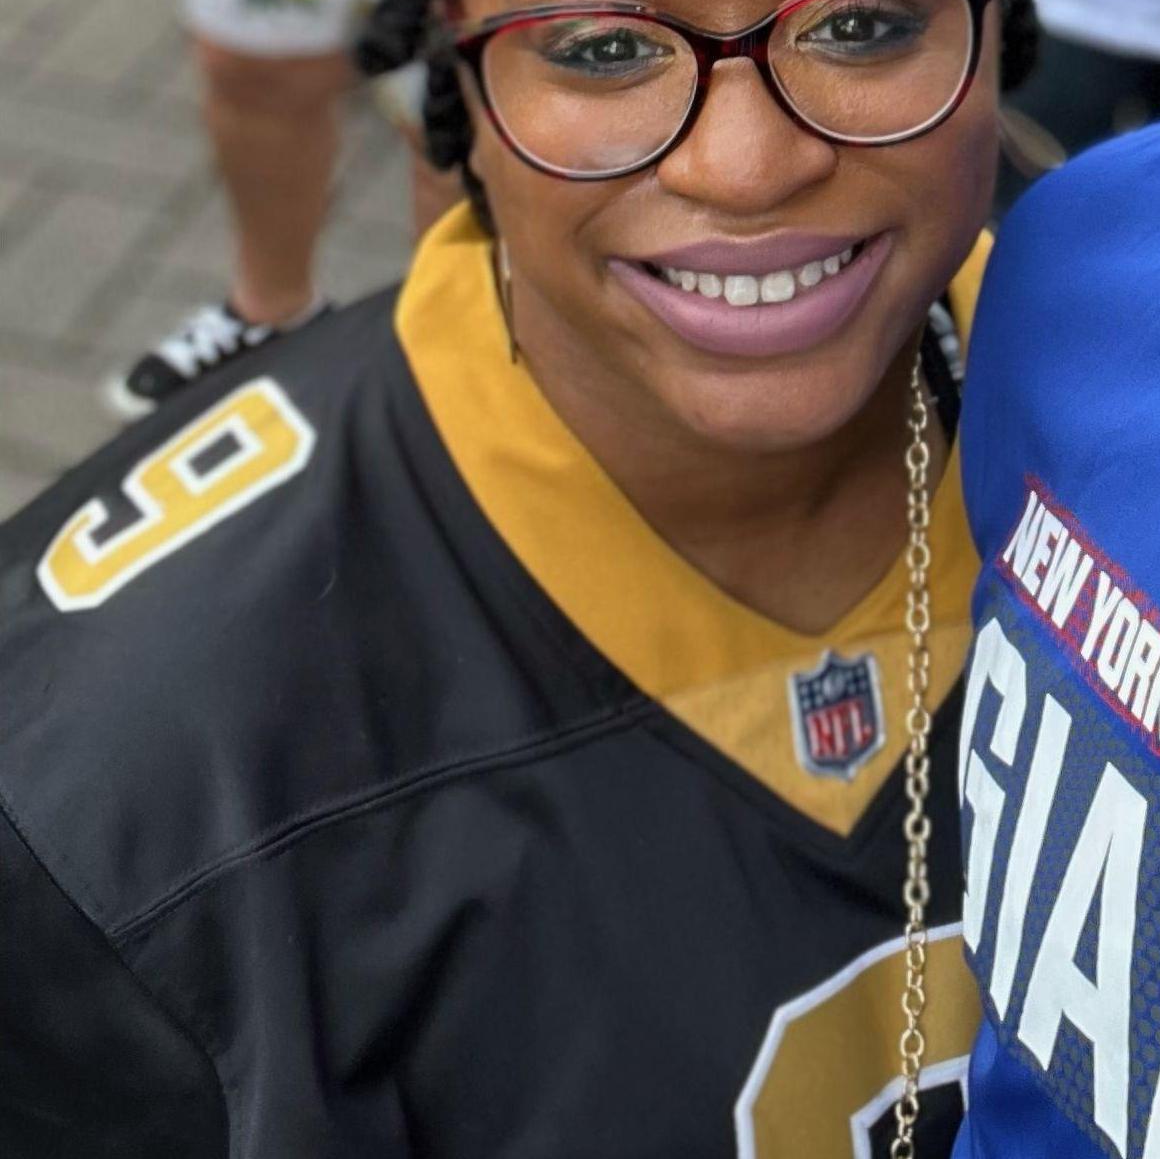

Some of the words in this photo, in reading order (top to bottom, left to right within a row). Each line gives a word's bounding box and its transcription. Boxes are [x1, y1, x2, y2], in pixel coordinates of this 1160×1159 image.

[36, 375, 318, 613] 9
[1002, 490, 1094, 630] NEW
[806, 698, 872, 760] NFL
